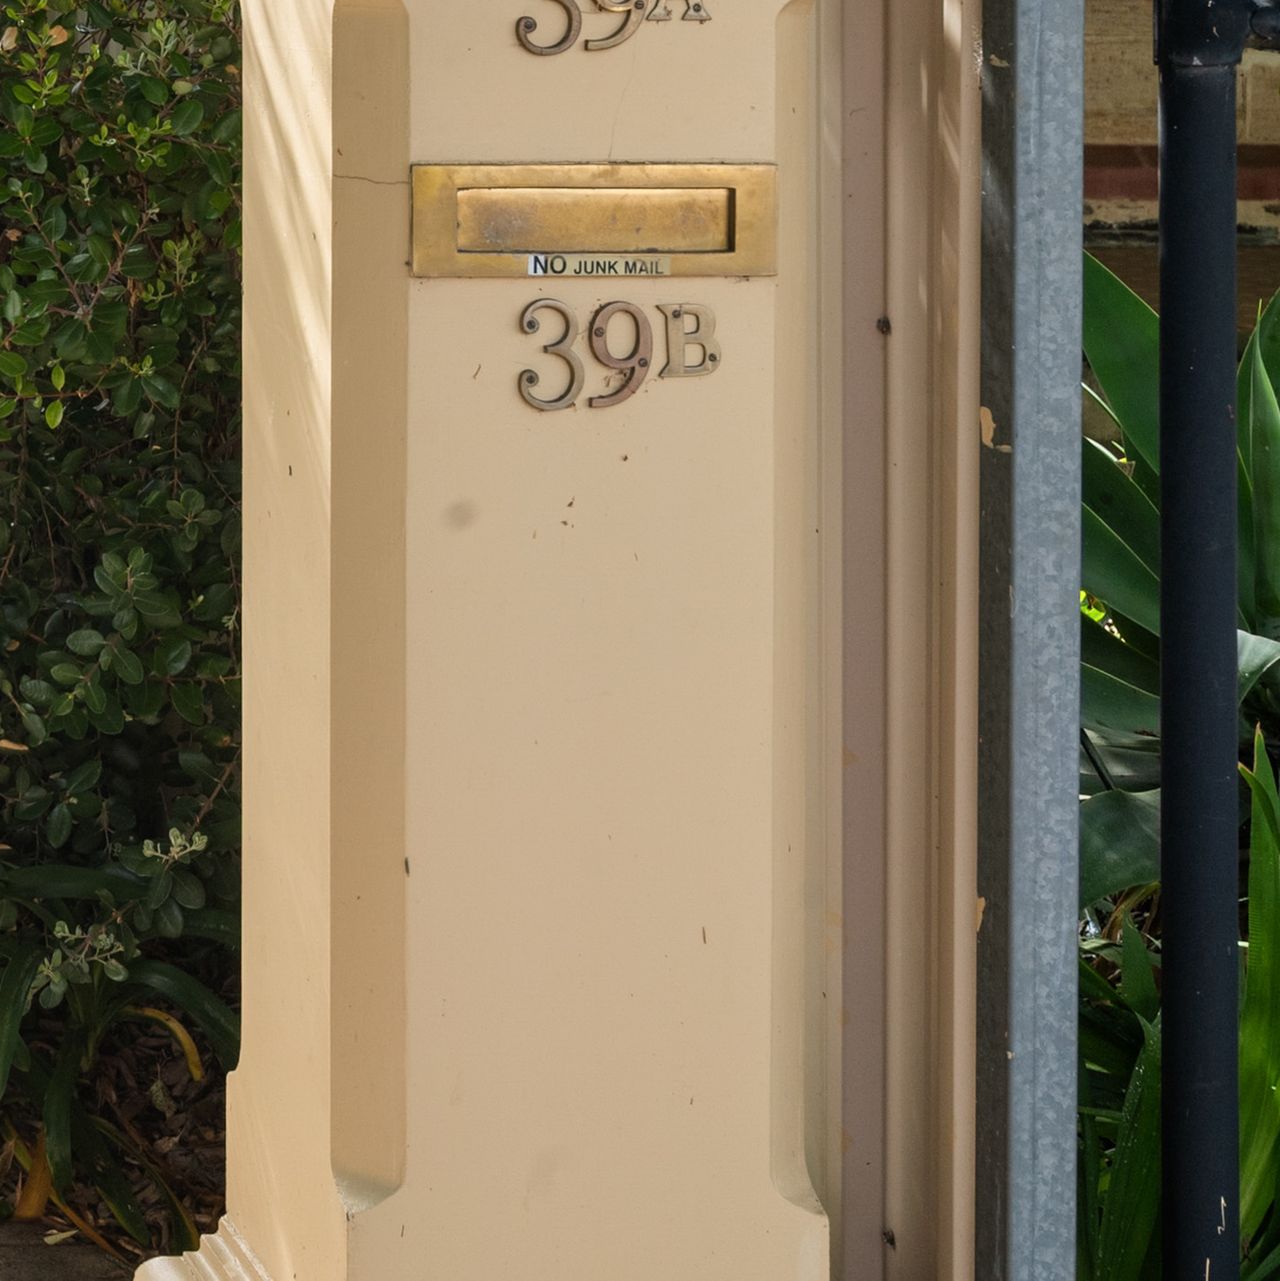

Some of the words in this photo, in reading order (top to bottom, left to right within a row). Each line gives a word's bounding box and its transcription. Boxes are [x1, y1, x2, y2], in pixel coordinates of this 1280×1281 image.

[533, 255, 567, 274] NO
[573, 260, 618, 275] JUNK
[624, 260, 664, 275] MAIL
[518, 298, 722, 411] 39B
